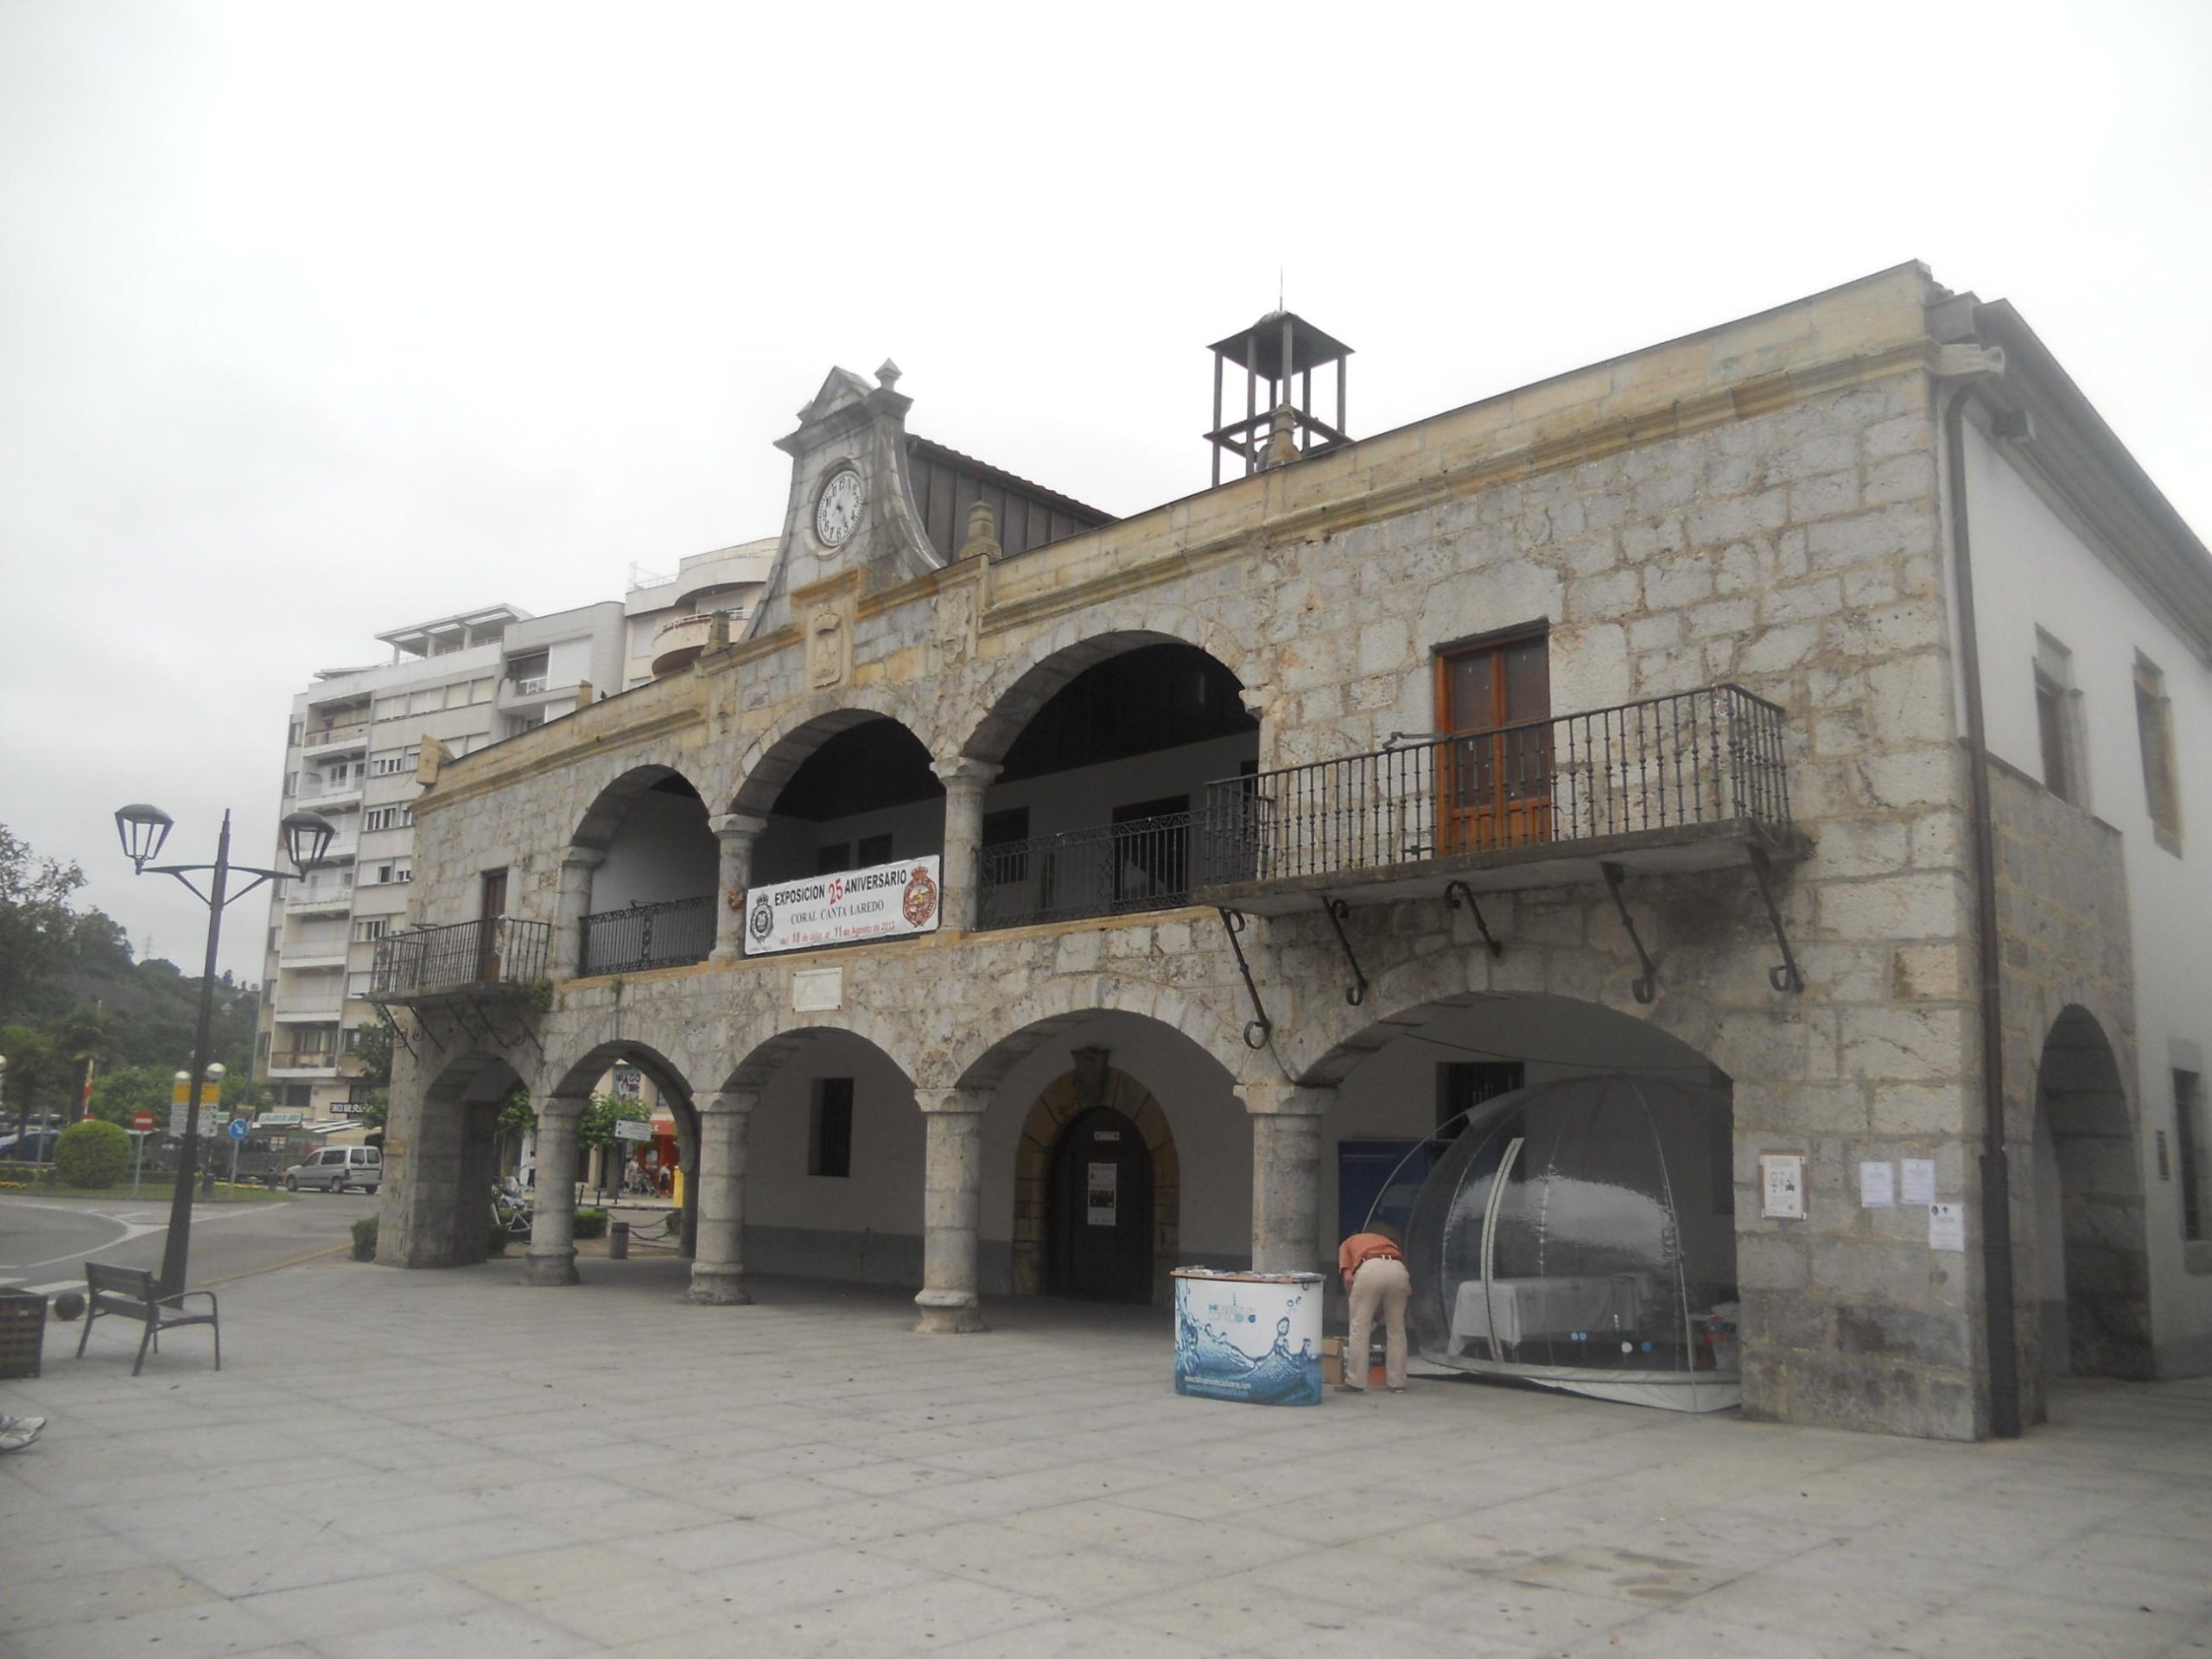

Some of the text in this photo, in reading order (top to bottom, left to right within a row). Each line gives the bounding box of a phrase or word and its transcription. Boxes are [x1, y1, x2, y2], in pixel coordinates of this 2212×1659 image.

[774, 869, 907, 906] EXPOSICION 25 ANIVERSARIO
[791, 899, 885, 925] CORAL CANTA LAREDO
[835, 926, 842, 937] 11
